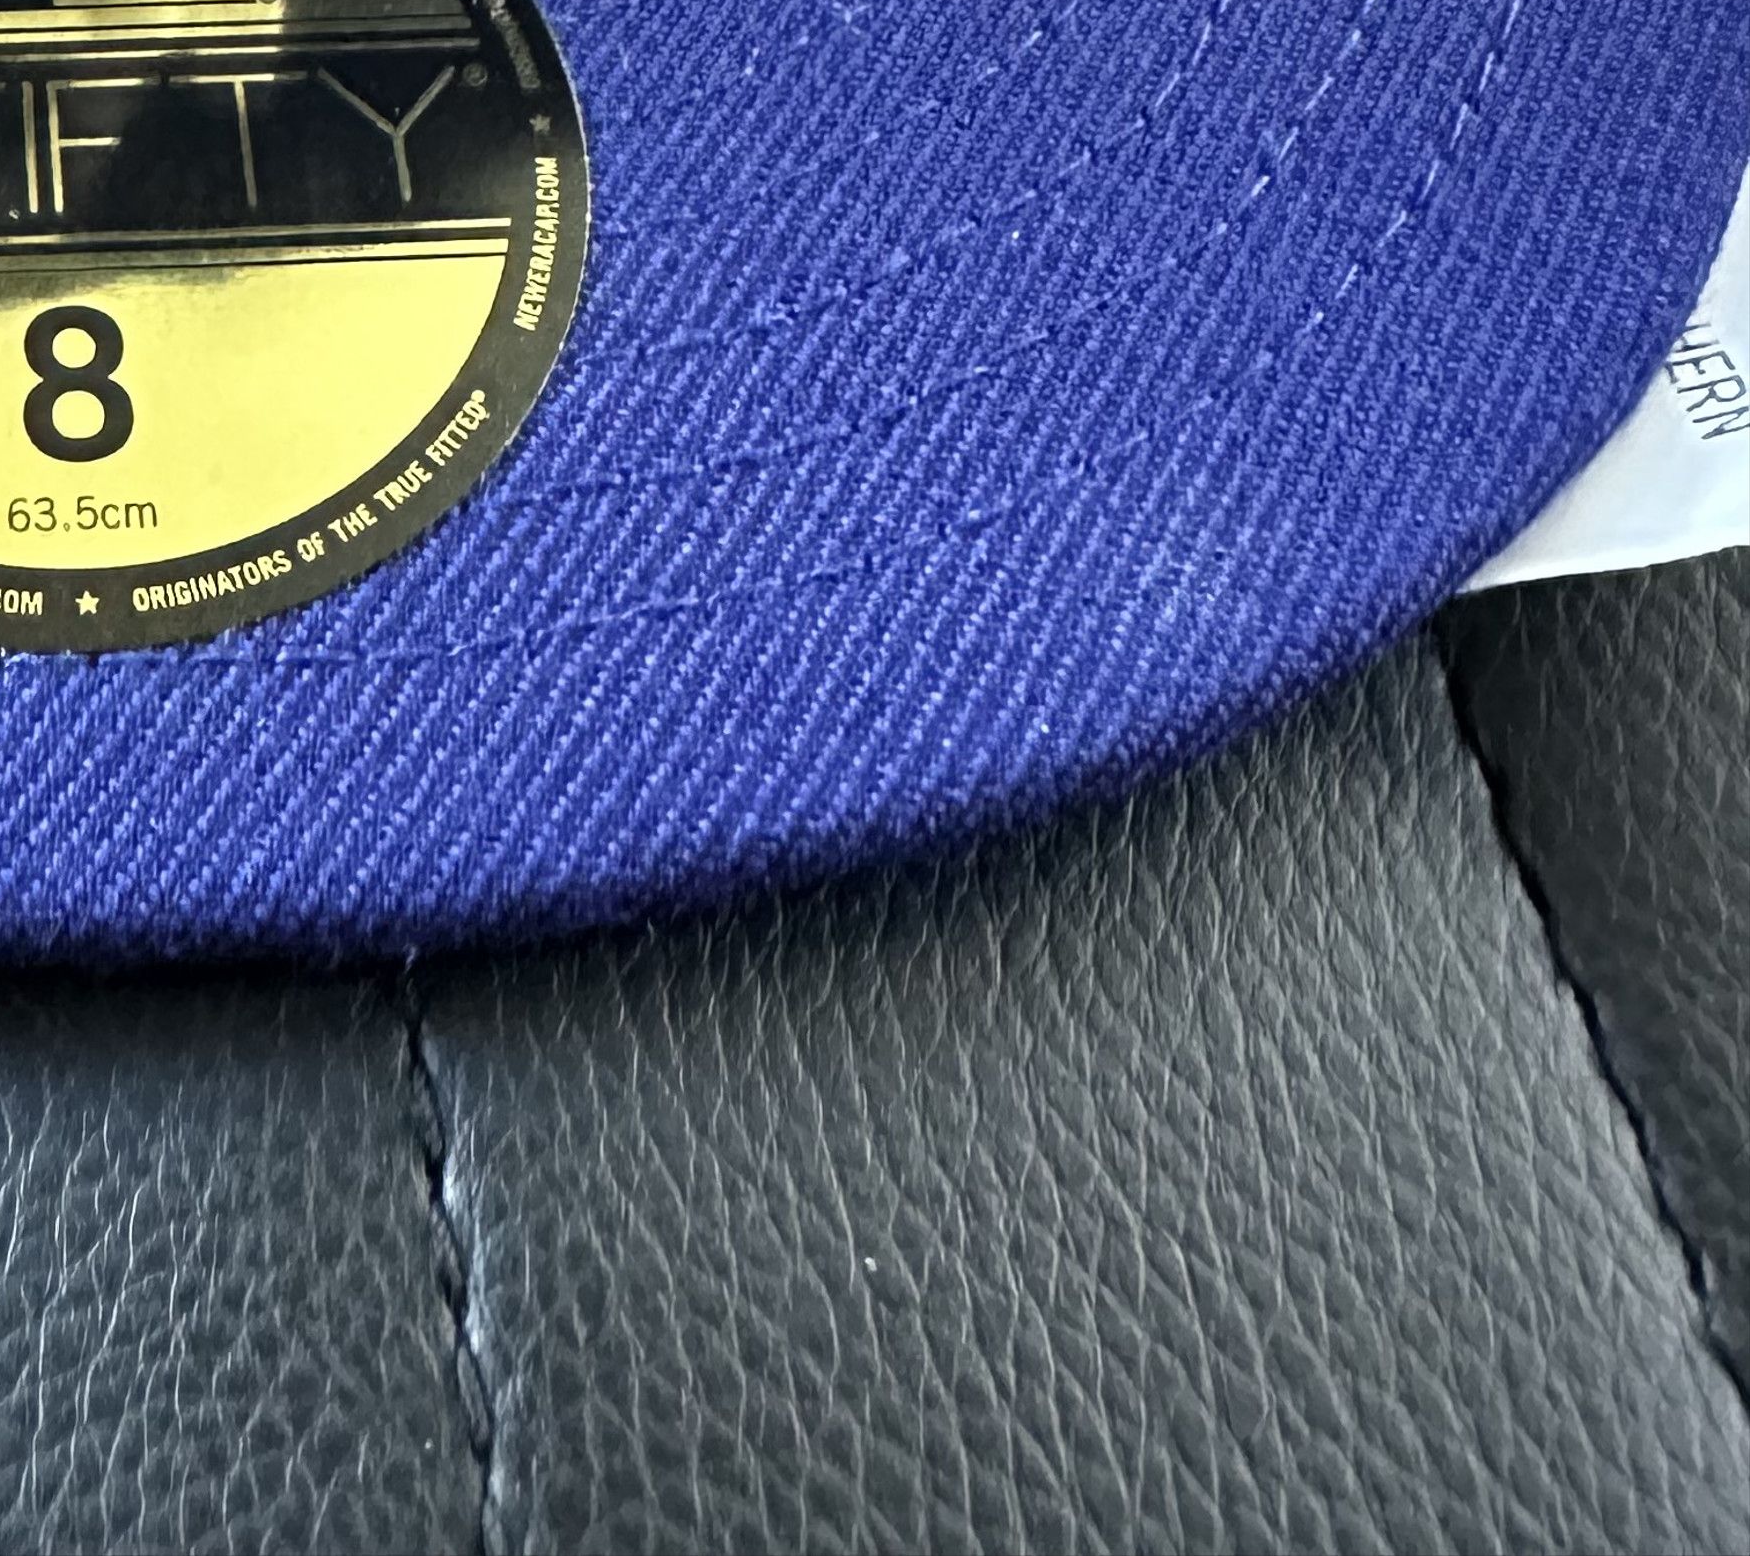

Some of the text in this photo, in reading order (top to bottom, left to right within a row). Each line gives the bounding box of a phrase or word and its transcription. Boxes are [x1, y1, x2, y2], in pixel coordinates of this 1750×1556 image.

[512, 156, 561, 332] NEWERACAP.COM
[22, 305, 135, 462] 8
[7, 494, 158, 533] 63.5cm
[131, 549, 293, 613] ORIGINATORS
[296, 531, 326, 563] OF
[326, 502, 379, 543] THE
[372, 459, 433, 512] TRUE
